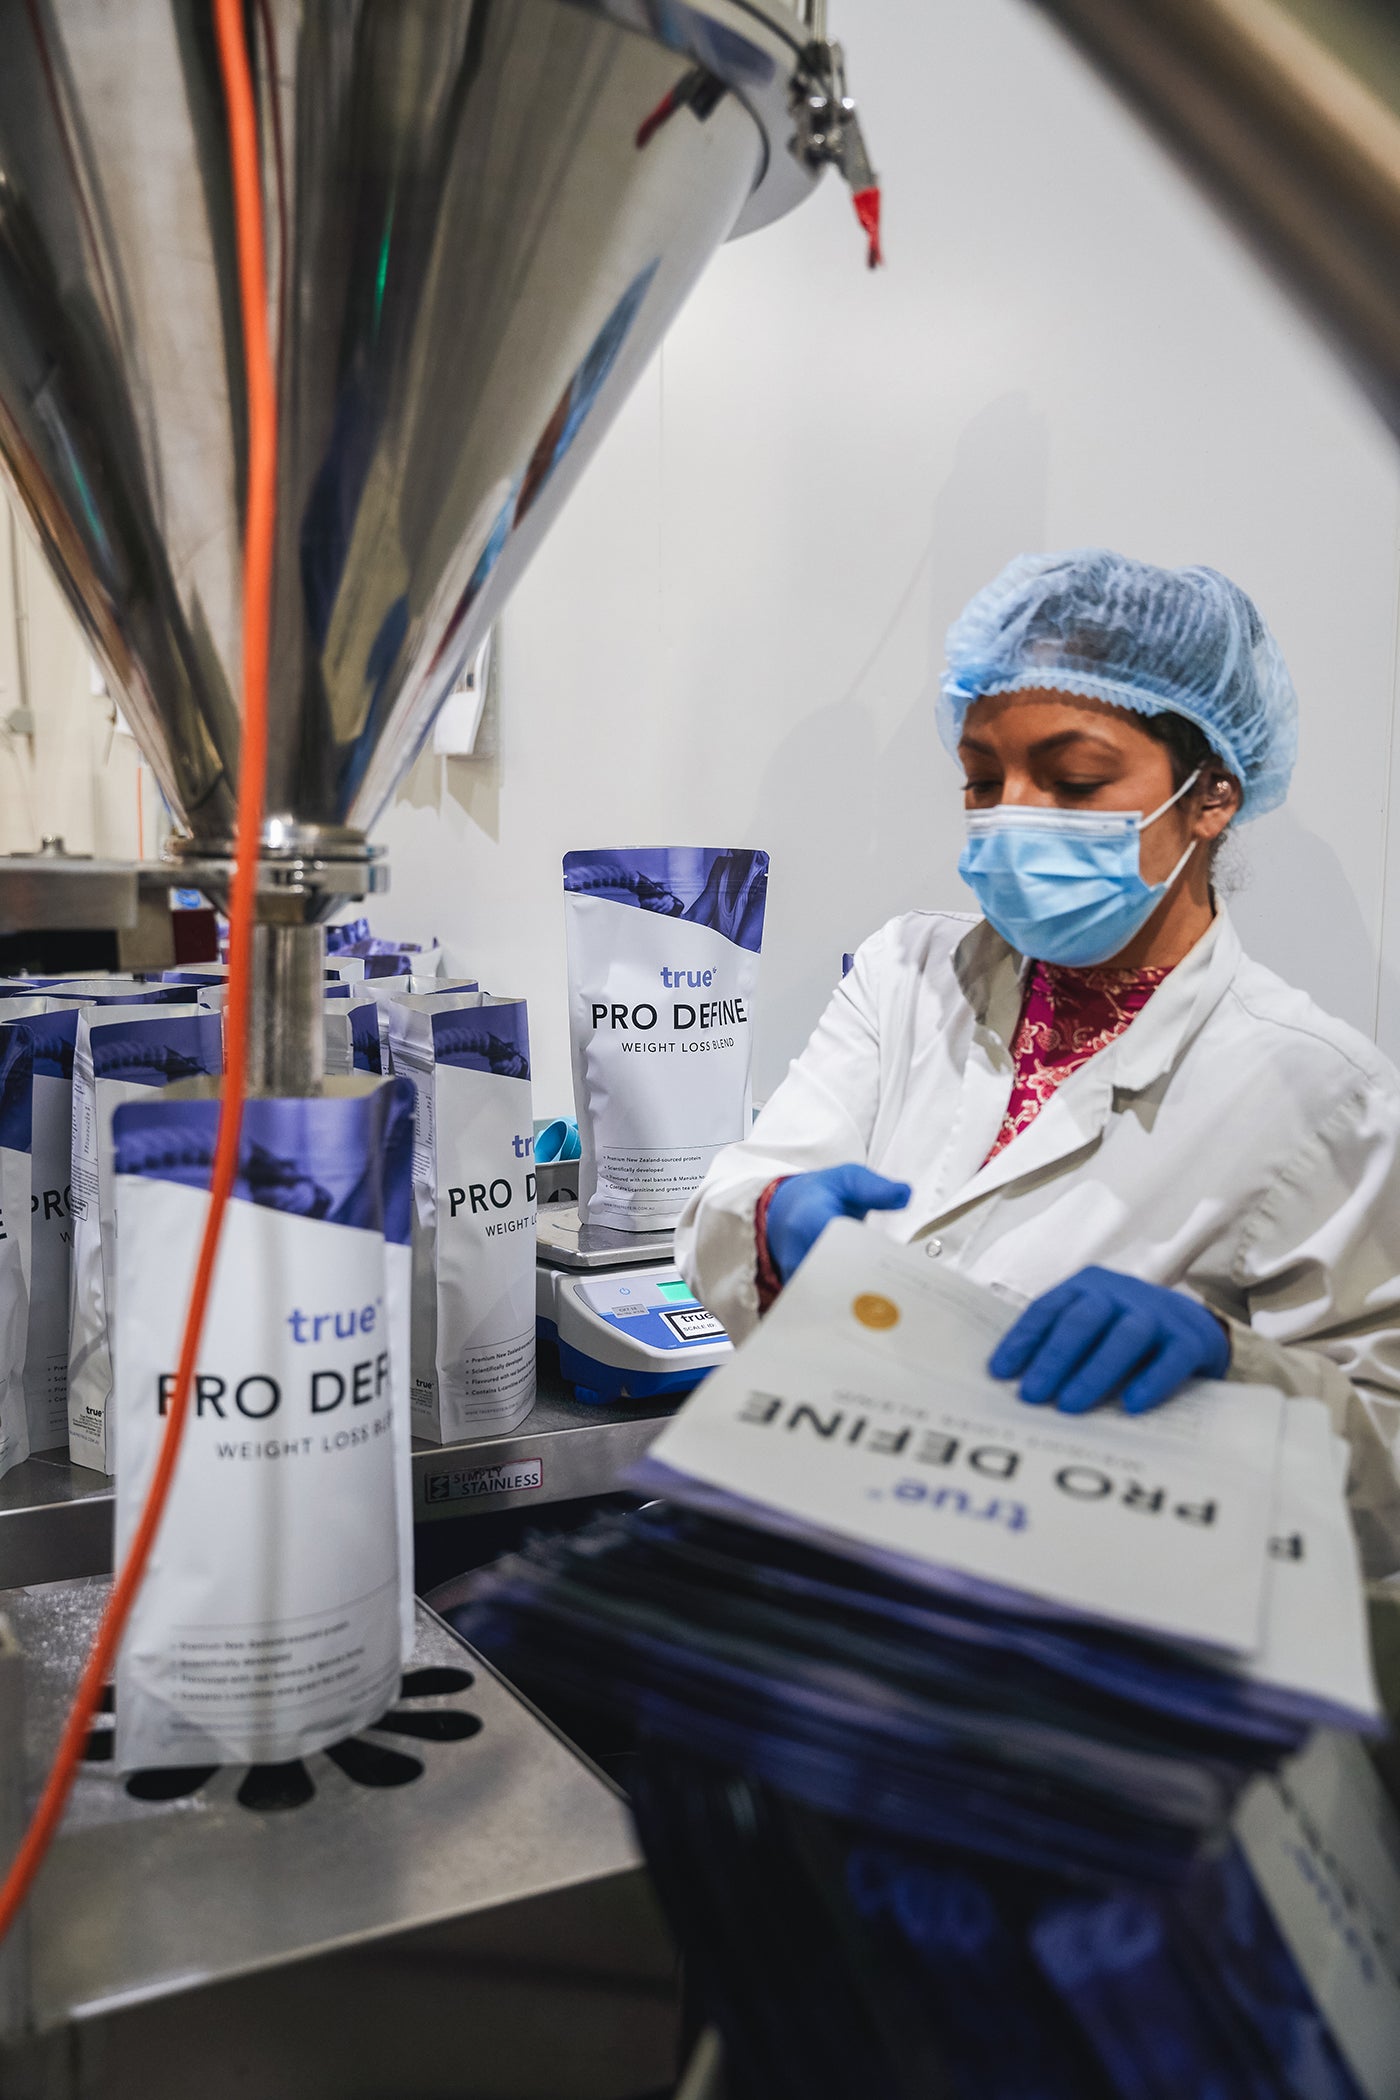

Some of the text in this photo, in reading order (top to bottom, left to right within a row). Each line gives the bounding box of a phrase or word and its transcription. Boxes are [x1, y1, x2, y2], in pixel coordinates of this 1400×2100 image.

[661, 967, 712, 988] true
[592, 998, 747, 1030] PRO DEFINE
[622, 1037, 734, 1053] WEIGHT LOSS BLEND
[512, 1135, 535, 1158] tr
[683, 1155, 701, 1163] protein
[448, 1178, 512, 1217] PRO
[485, 1217, 529, 1237] WEIGHT
[289, 1308, 376, 1343] true
[681, 1312, 715, 1323] true
[471, 1355, 495, 1363] Premium
[496, 1351, 506, 1359] New
[471, 1363, 504, 1375] Scientifically
[416, 1379, 432, 1389] true
[471, 1376, 499, 1385] Flavoured
[471, 1387, 496, 1396] Contains
[86, 1406, 102, 1417] true
[216, 1437, 313, 1460] WEIGHT
[322, 1424, 369, 1452] LOSS
[736, 1388, 1021, 1482] DEFINE
[454, 1465, 539, 1495] SIMPLY STAINLESS
[1053, 1464, 1219, 1527] PRO
[893, 1478, 1030, 1534] true
